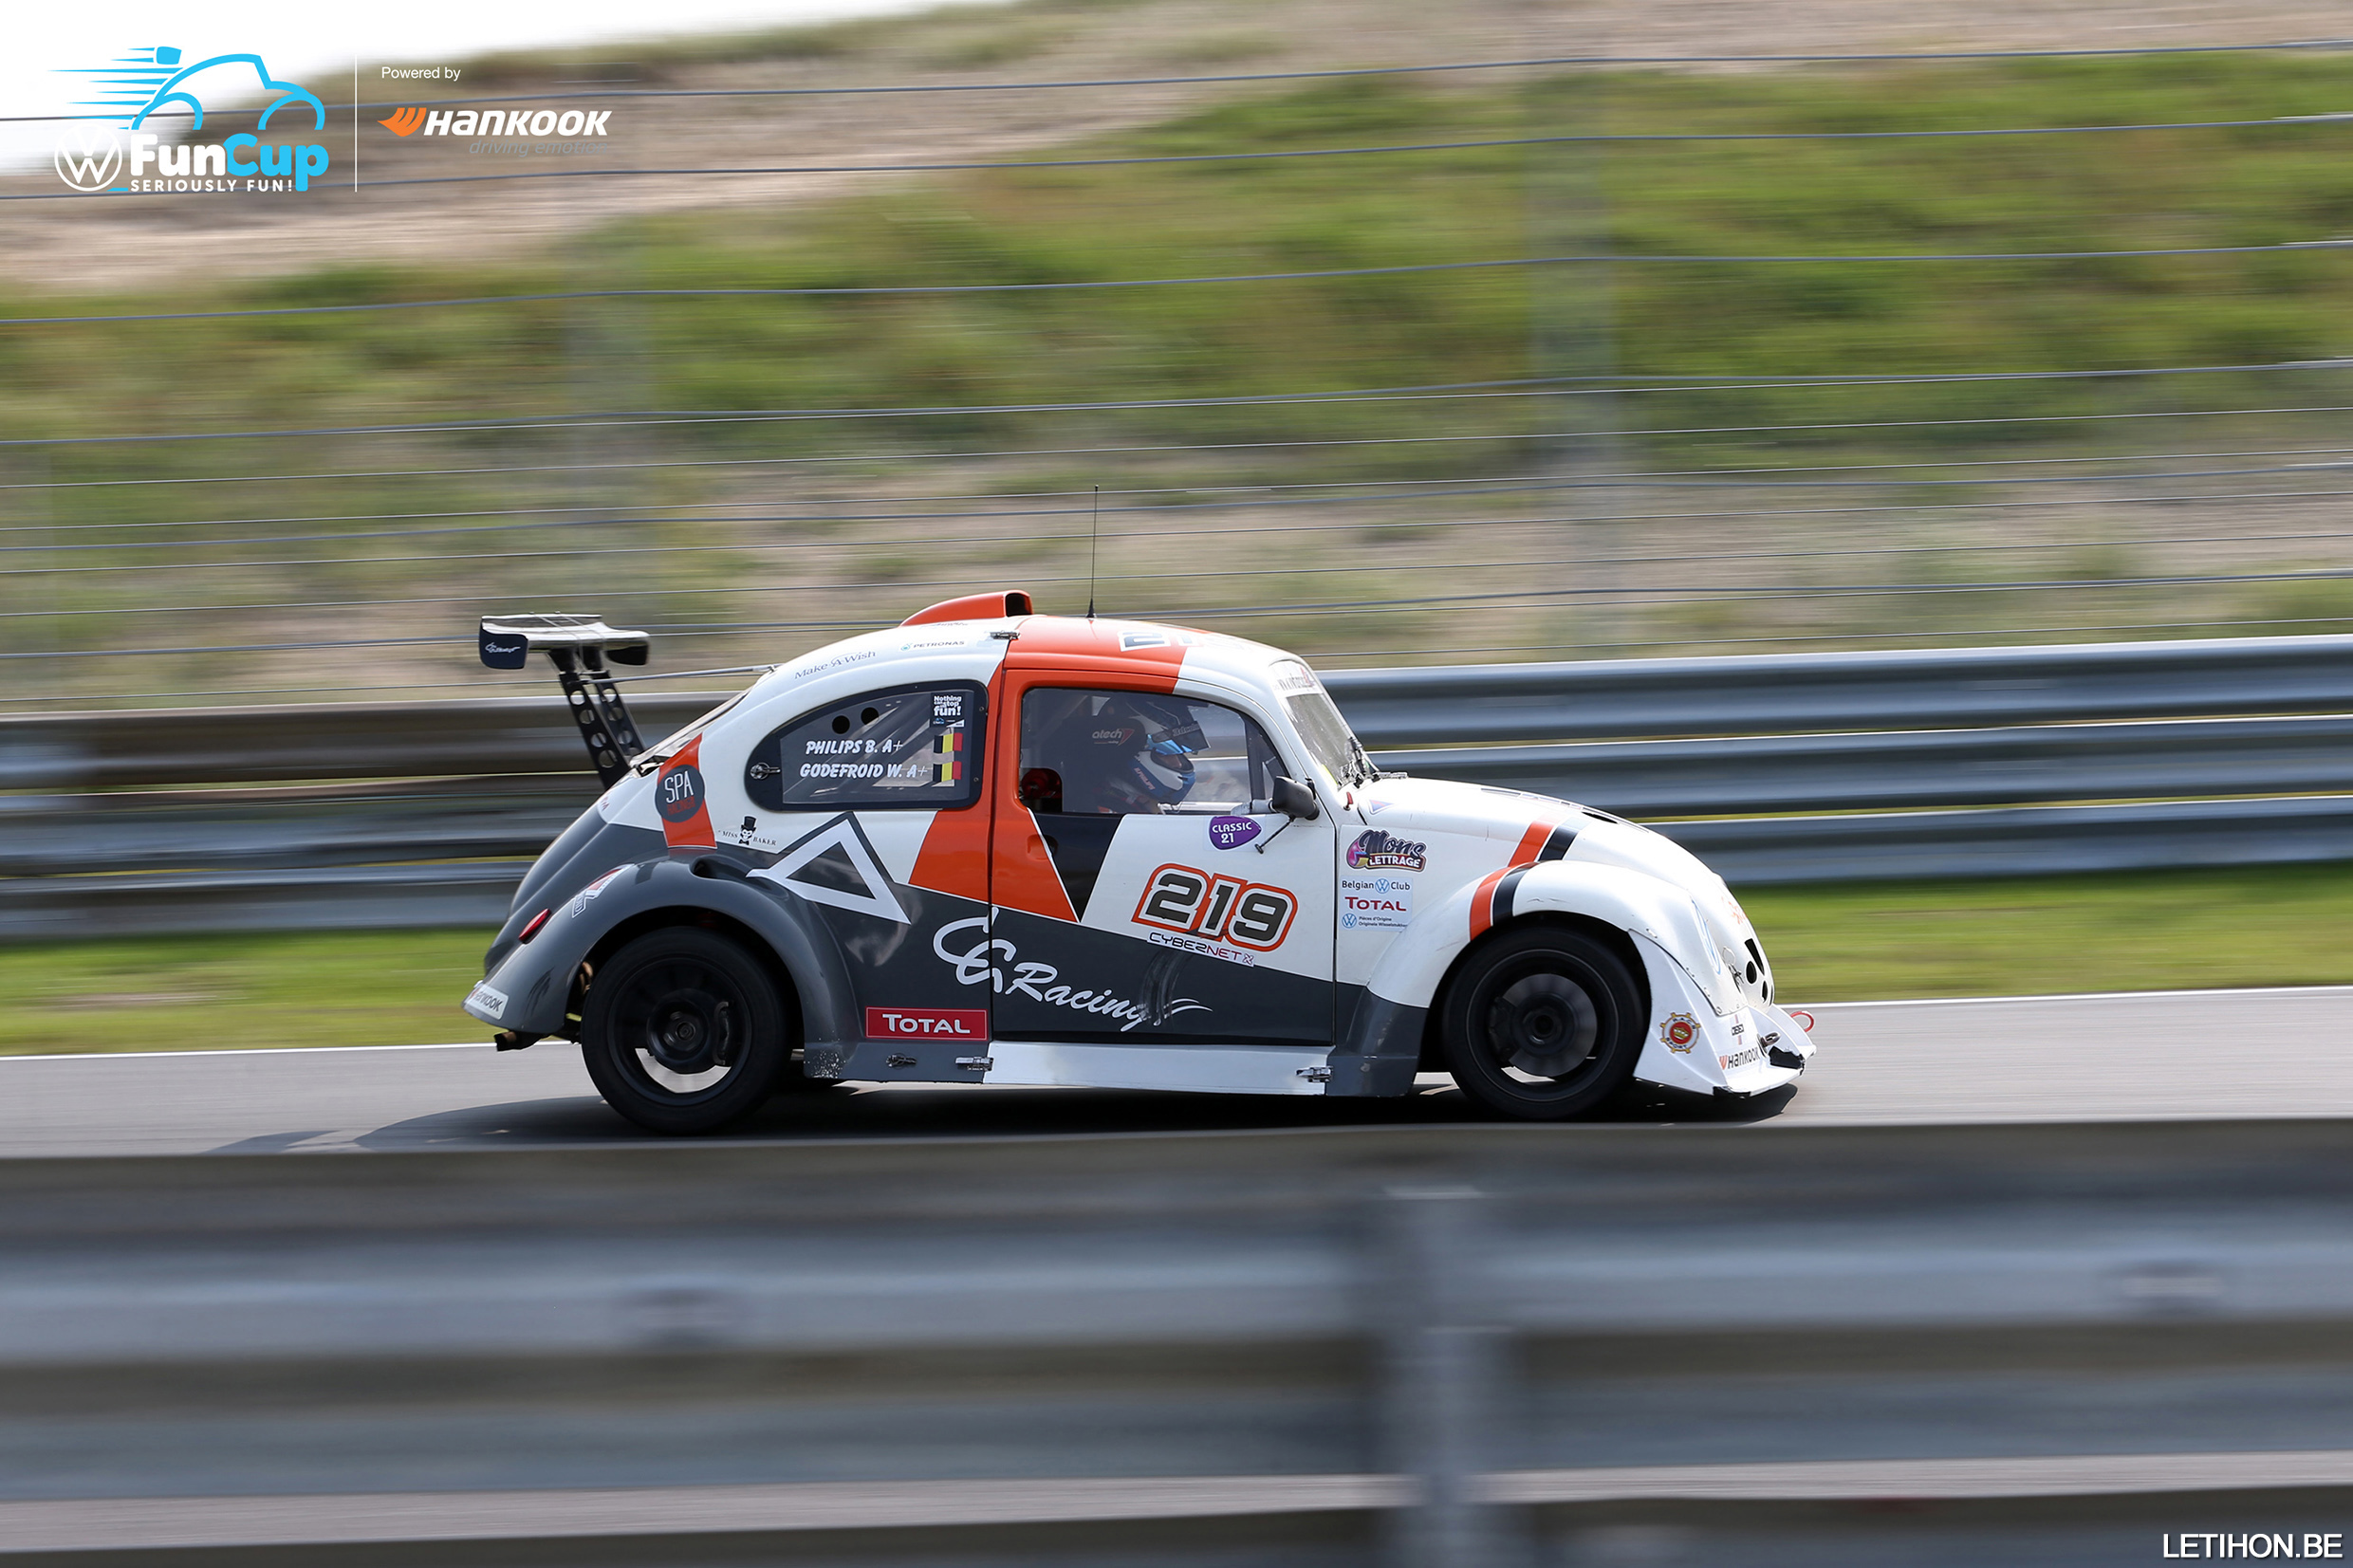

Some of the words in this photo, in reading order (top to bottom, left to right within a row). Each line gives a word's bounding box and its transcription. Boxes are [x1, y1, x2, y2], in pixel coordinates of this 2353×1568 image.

[934, 706, 962, 716] fun!
[1091, 728, 1123, 740] atech
[806, 739, 863, 755] PHILIPS
[864, 739, 879, 754] B.
[881, 739, 903, 754] A+
[799, 763, 884, 779] GODEFROID
[886, 764, 902, 778] W.
[906, 764, 928, 778] A+
[664, 770, 695, 803] SPA
[1212, 821, 1252, 833] CLASSIC
[722, 830, 738, 839] MISS
[752, 837, 777, 846] BAKER
[1220, 833, 1234, 843] 21
[1358, 829, 1427, 858] Mons
[1369, 855, 1421, 868] LETTRAGE
[1342, 880, 1374, 891] Belgian
[1391, 881, 1411, 891] Club
[1139, 868, 1293, 947] 219
[1344, 896, 1406, 912] TOTAL
[1005, 962, 1152, 1033] Racing
[881, 1013, 971, 1034] TOTAL
